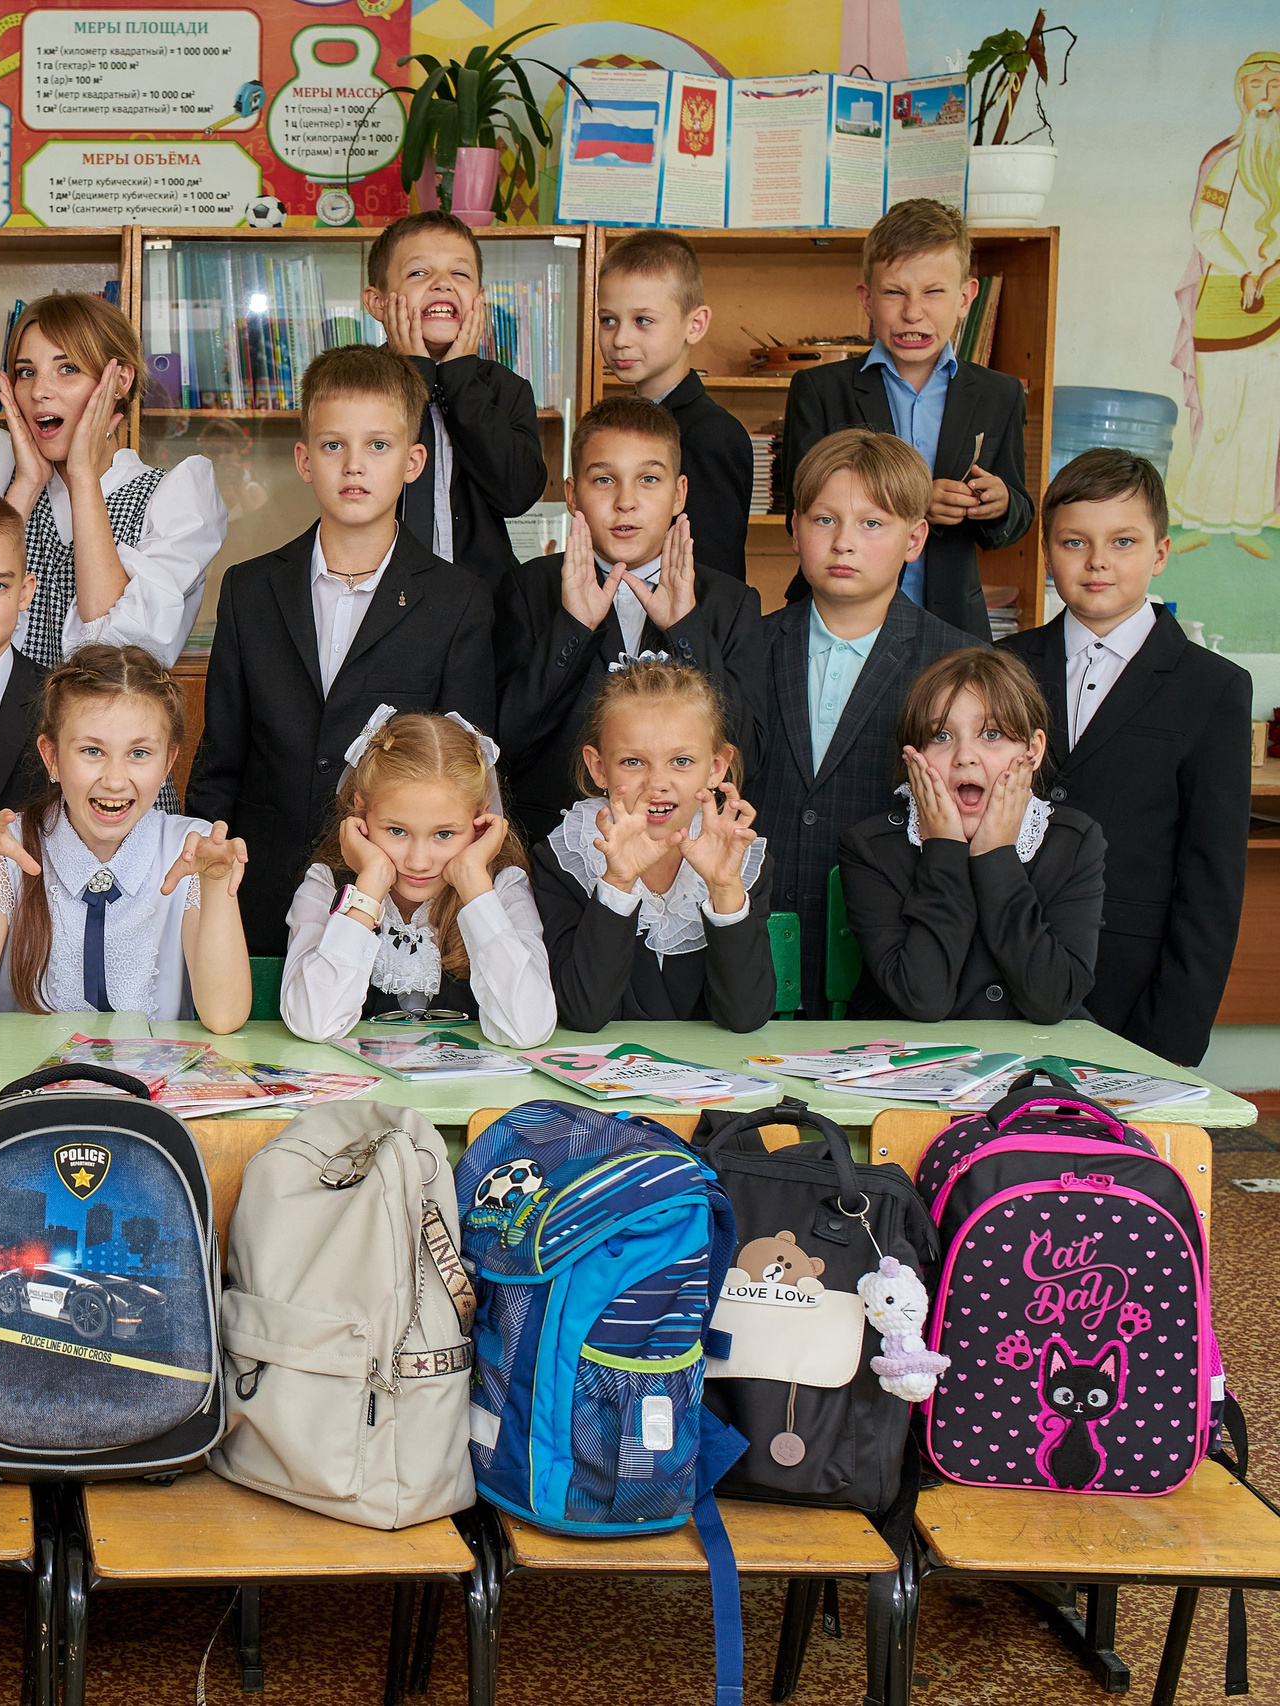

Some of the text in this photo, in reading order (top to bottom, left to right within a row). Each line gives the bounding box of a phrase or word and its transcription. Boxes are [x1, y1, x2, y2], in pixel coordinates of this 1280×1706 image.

[74, 21, 208, 36] МЕРЫ ПЛОЩАДИ
[44, 47, 58, 55] км²
[60, 46, 107, 57] (километр
[110, 46, 168, 57] квадратный)
[44, 62, 53, 70] га
[99, 62, 108, 70] 10
[76, 76, 90, 84] 100
[55, 89, 79, 100] (метр
[82, 89, 140, 100] квадратный)
[293, 87, 385, 98] МЕРЫ МАССЫ
[59, 103, 109, 114] (сантиметр
[112, 103, 170, 115] квадратный)
[180, 105, 195, 113] 100
[299, 104, 332, 115] (тонна)
[299, 119, 344, 129] (центнер)
[303, 134, 359, 143] (килограмм)
[82, 151, 201, 165] МЕРЫ ОБЪЁМА
[298, 147, 332, 158] (грамм)
[68, 176, 93, 187] (метр
[96, 176, 151, 187] кубический)
[72, 190, 119, 201] (дециметр
[122, 190, 178, 201] кубический)
[72, 204, 123, 215] (сантиметр
[125, 204, 182, 215] кубический)
[542, 1053, 597, 1070] 3
[60, 1148, 106, 1164] POLICE
[1023, 1229, 1097, 1282] Cat
[727, 1287, 815, 1303] LOVE LOVE
[1024, 1272, 1114, 1330] Day
[21, 1334, 112, 1363] POLICE LINE DO NOT CROSS
